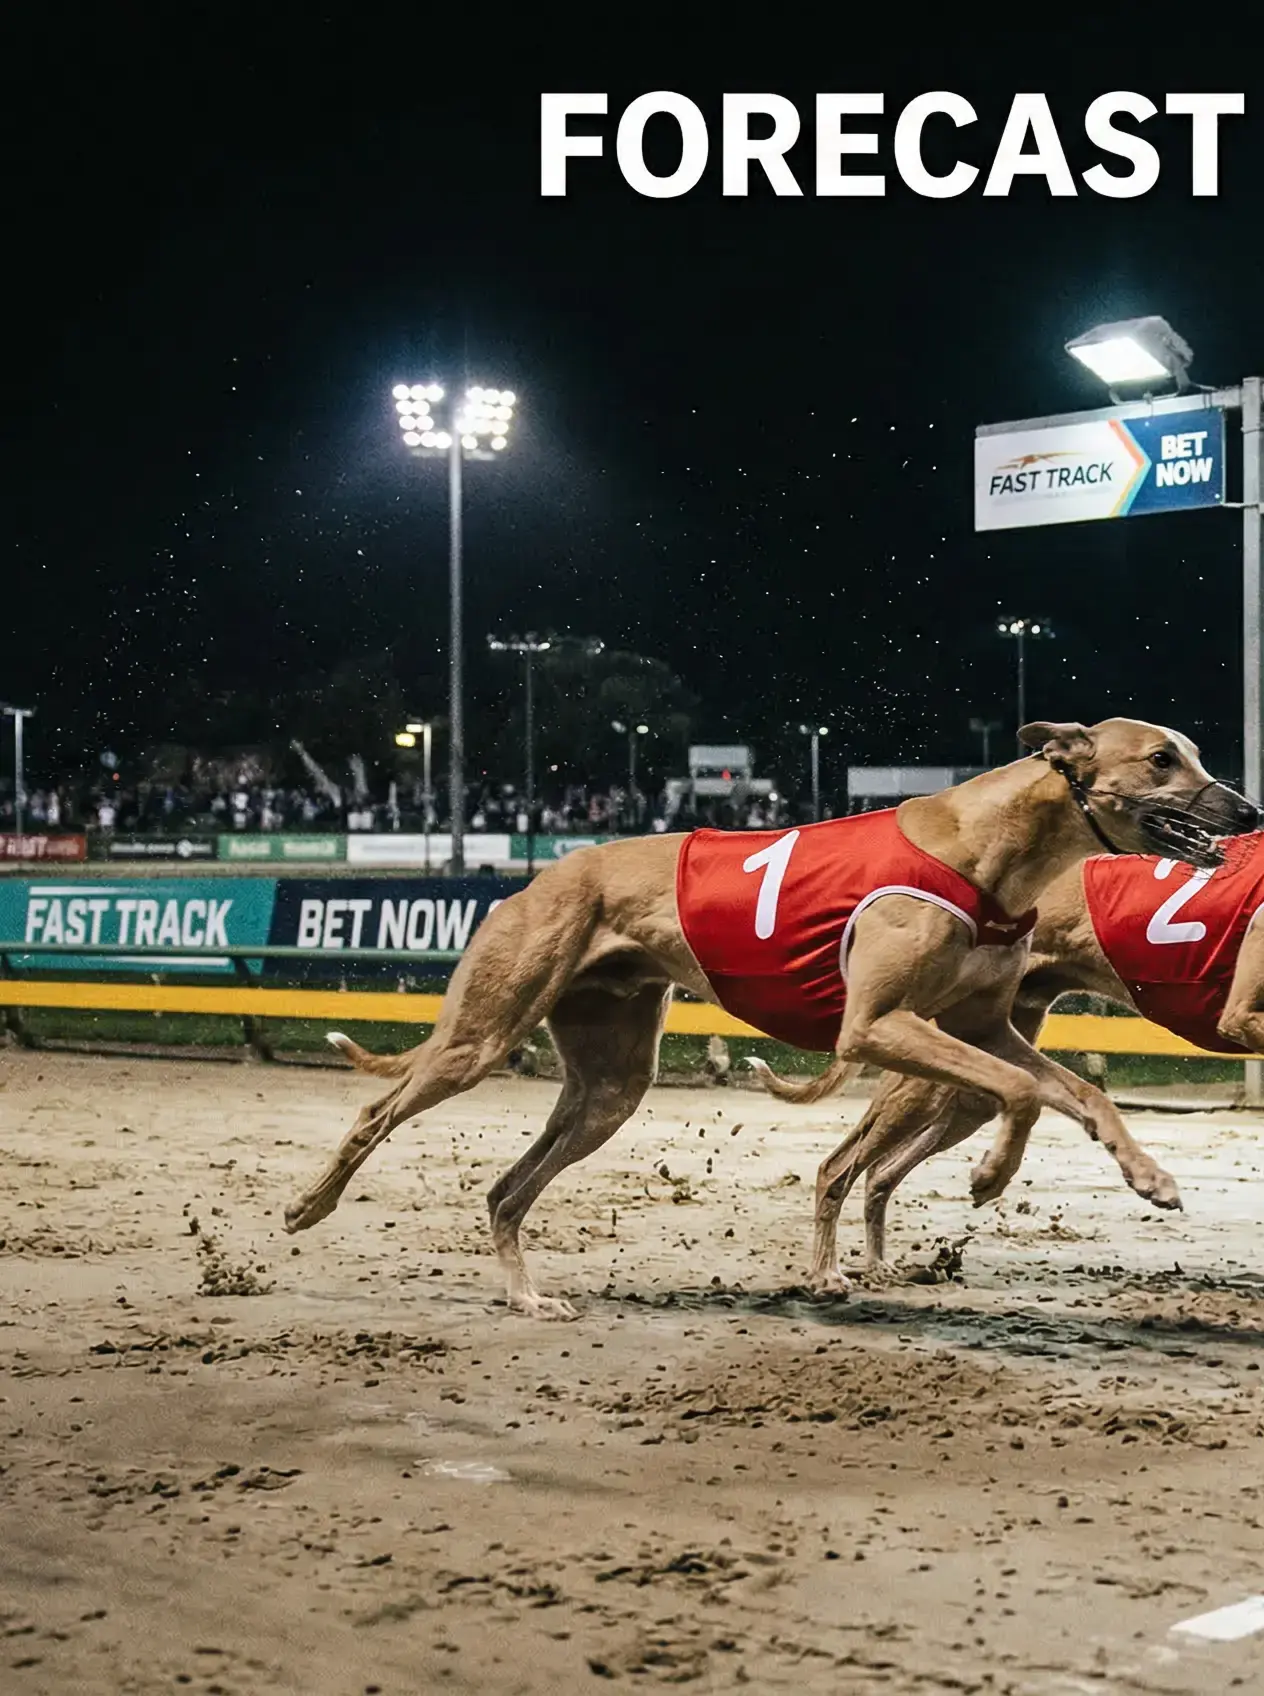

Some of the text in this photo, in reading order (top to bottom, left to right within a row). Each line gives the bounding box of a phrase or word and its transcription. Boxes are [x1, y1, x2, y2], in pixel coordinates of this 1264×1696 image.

[1160, 430, 1208, 461] BET
[989, 462, 1114, 497] FAST TRACK
[1156, 457, 1214, 488] NOW
[742, 830, 800, 940] 1
[1146, 857, 1217, 945] 2
[25, 899, 233, 947] FAST TRACK
[298, 899, 478, 949] BET NOW
